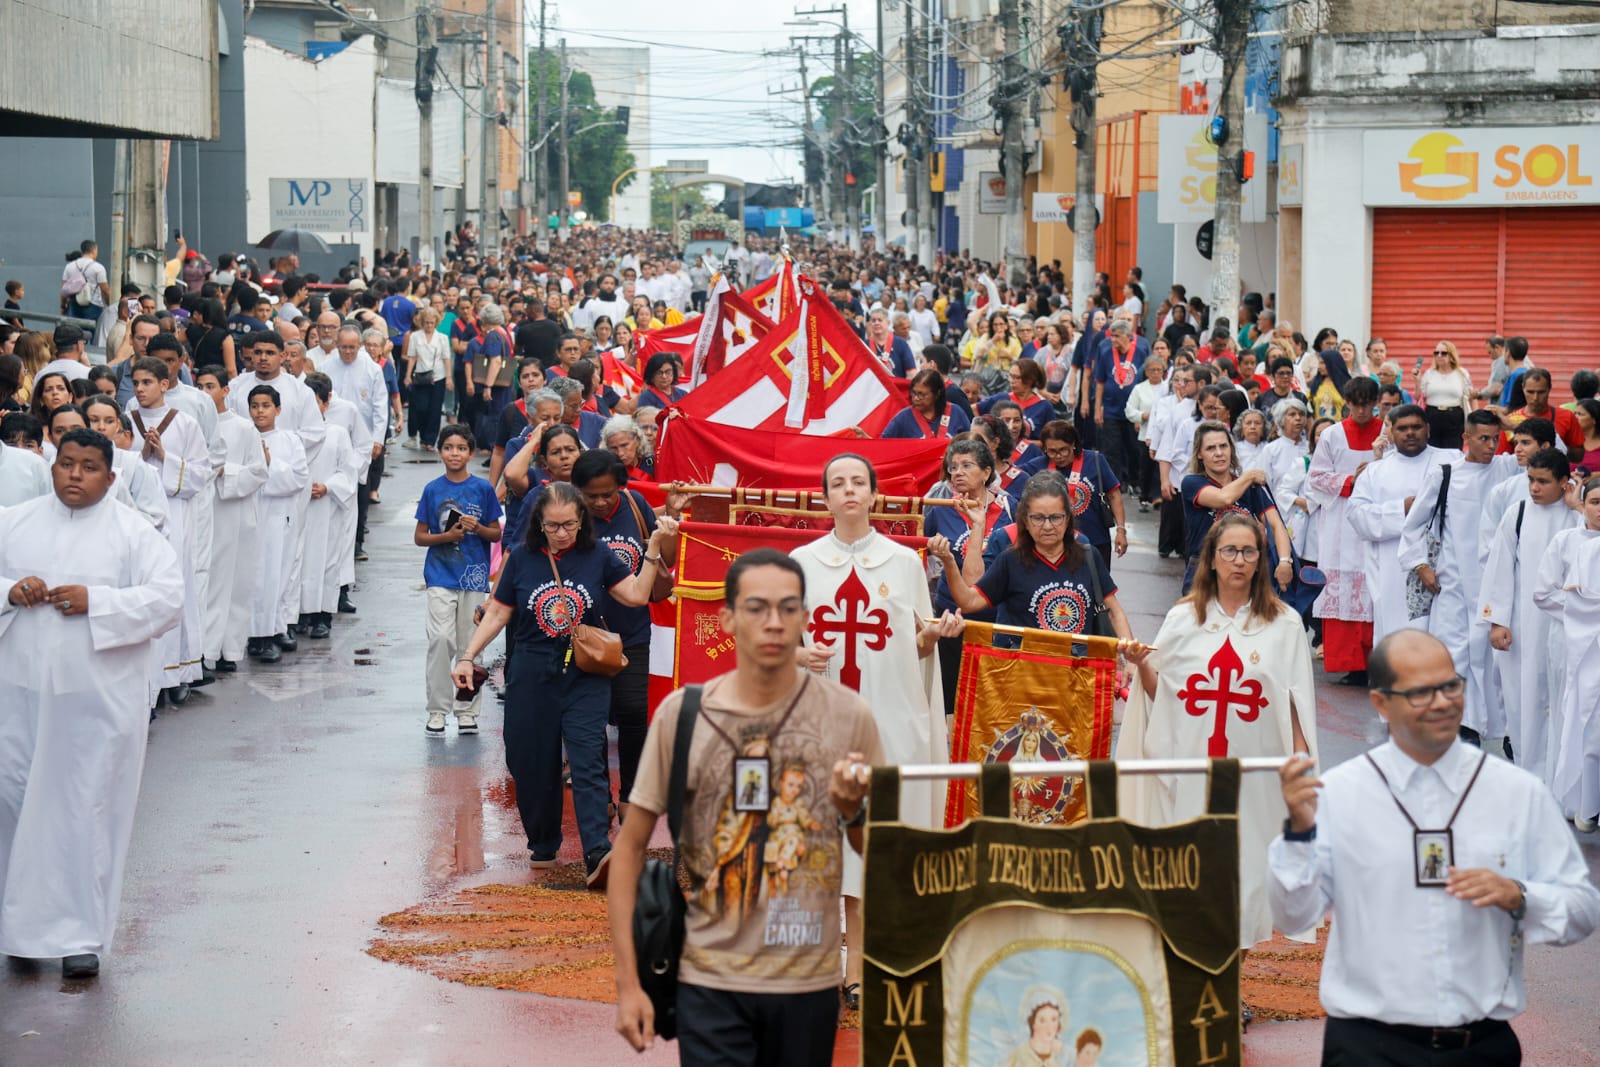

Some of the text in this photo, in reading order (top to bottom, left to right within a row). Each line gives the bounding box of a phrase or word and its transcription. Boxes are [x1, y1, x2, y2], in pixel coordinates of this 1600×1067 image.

[1492, 144, 1593, 188] SOL
[288, 180, 331, 206] MP
[1505, 191, 1578, 200] EMBALAGENS
[563, 579, 574, 587] da
[1028, 580, 1059, 613] Apostolado
[1063, 580, 1073, 588] da
[988, 842, 1086, 893] TERCEIRA
[1090, 843, 1124, 891] DO
[765, 923, 822, 946] CARMO
